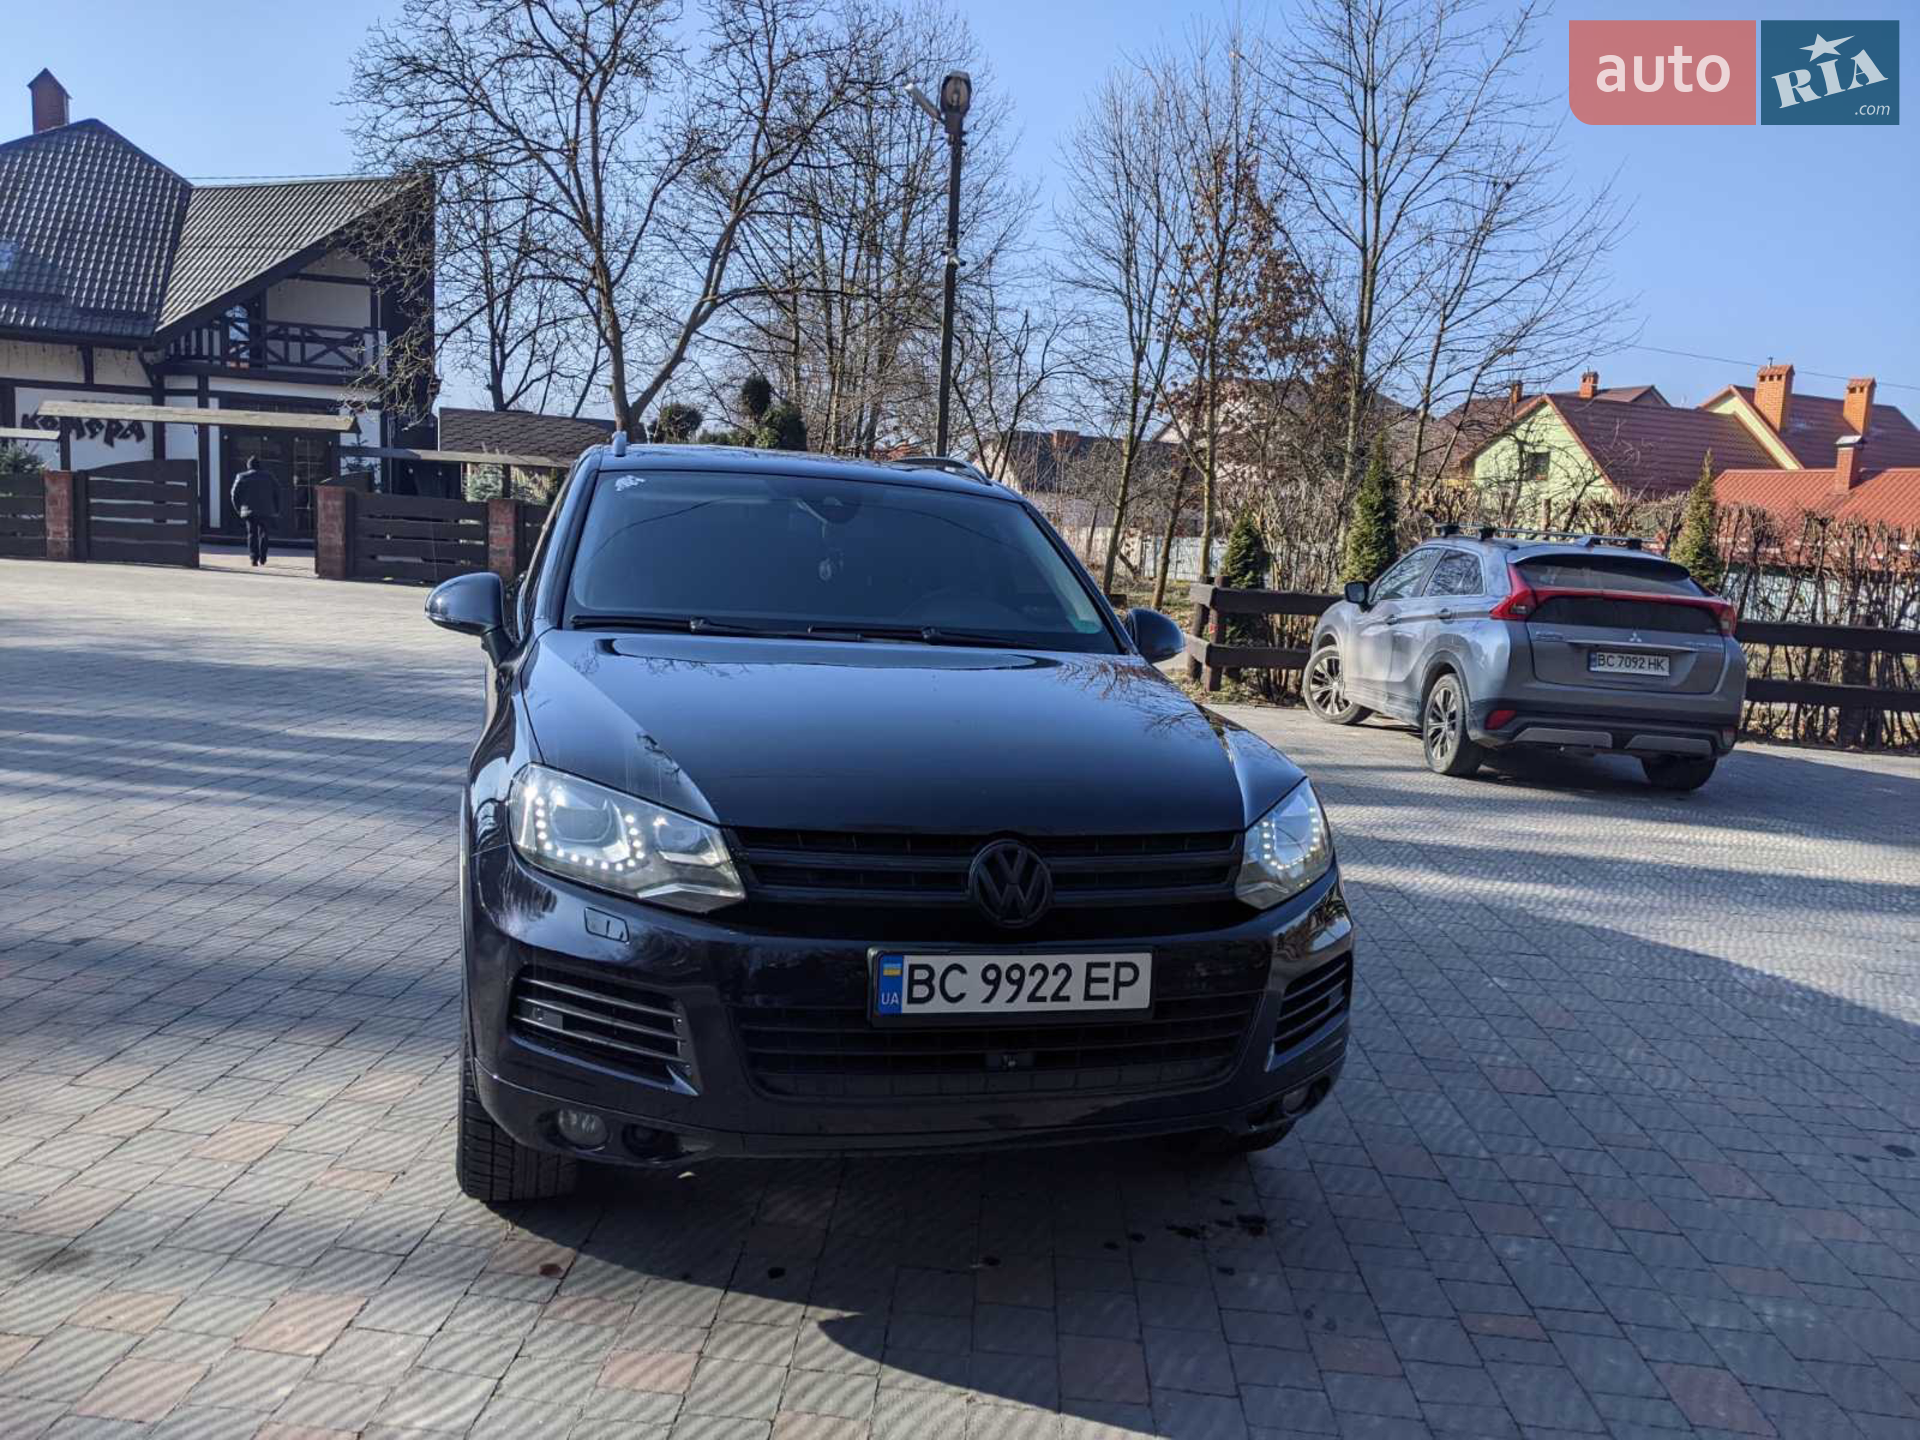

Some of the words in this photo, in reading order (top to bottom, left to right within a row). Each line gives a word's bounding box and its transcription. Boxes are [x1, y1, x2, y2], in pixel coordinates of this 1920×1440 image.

[1597, 653, 1615, 667] BC
[1617, 654, 1645, 669] 7092
[906, 963, 967, 1005] BC
[980, 962, 1073, 1004] 9922
[1083, 961, 1140, 1002] EP
[881, 992, 900, 1005] UA
